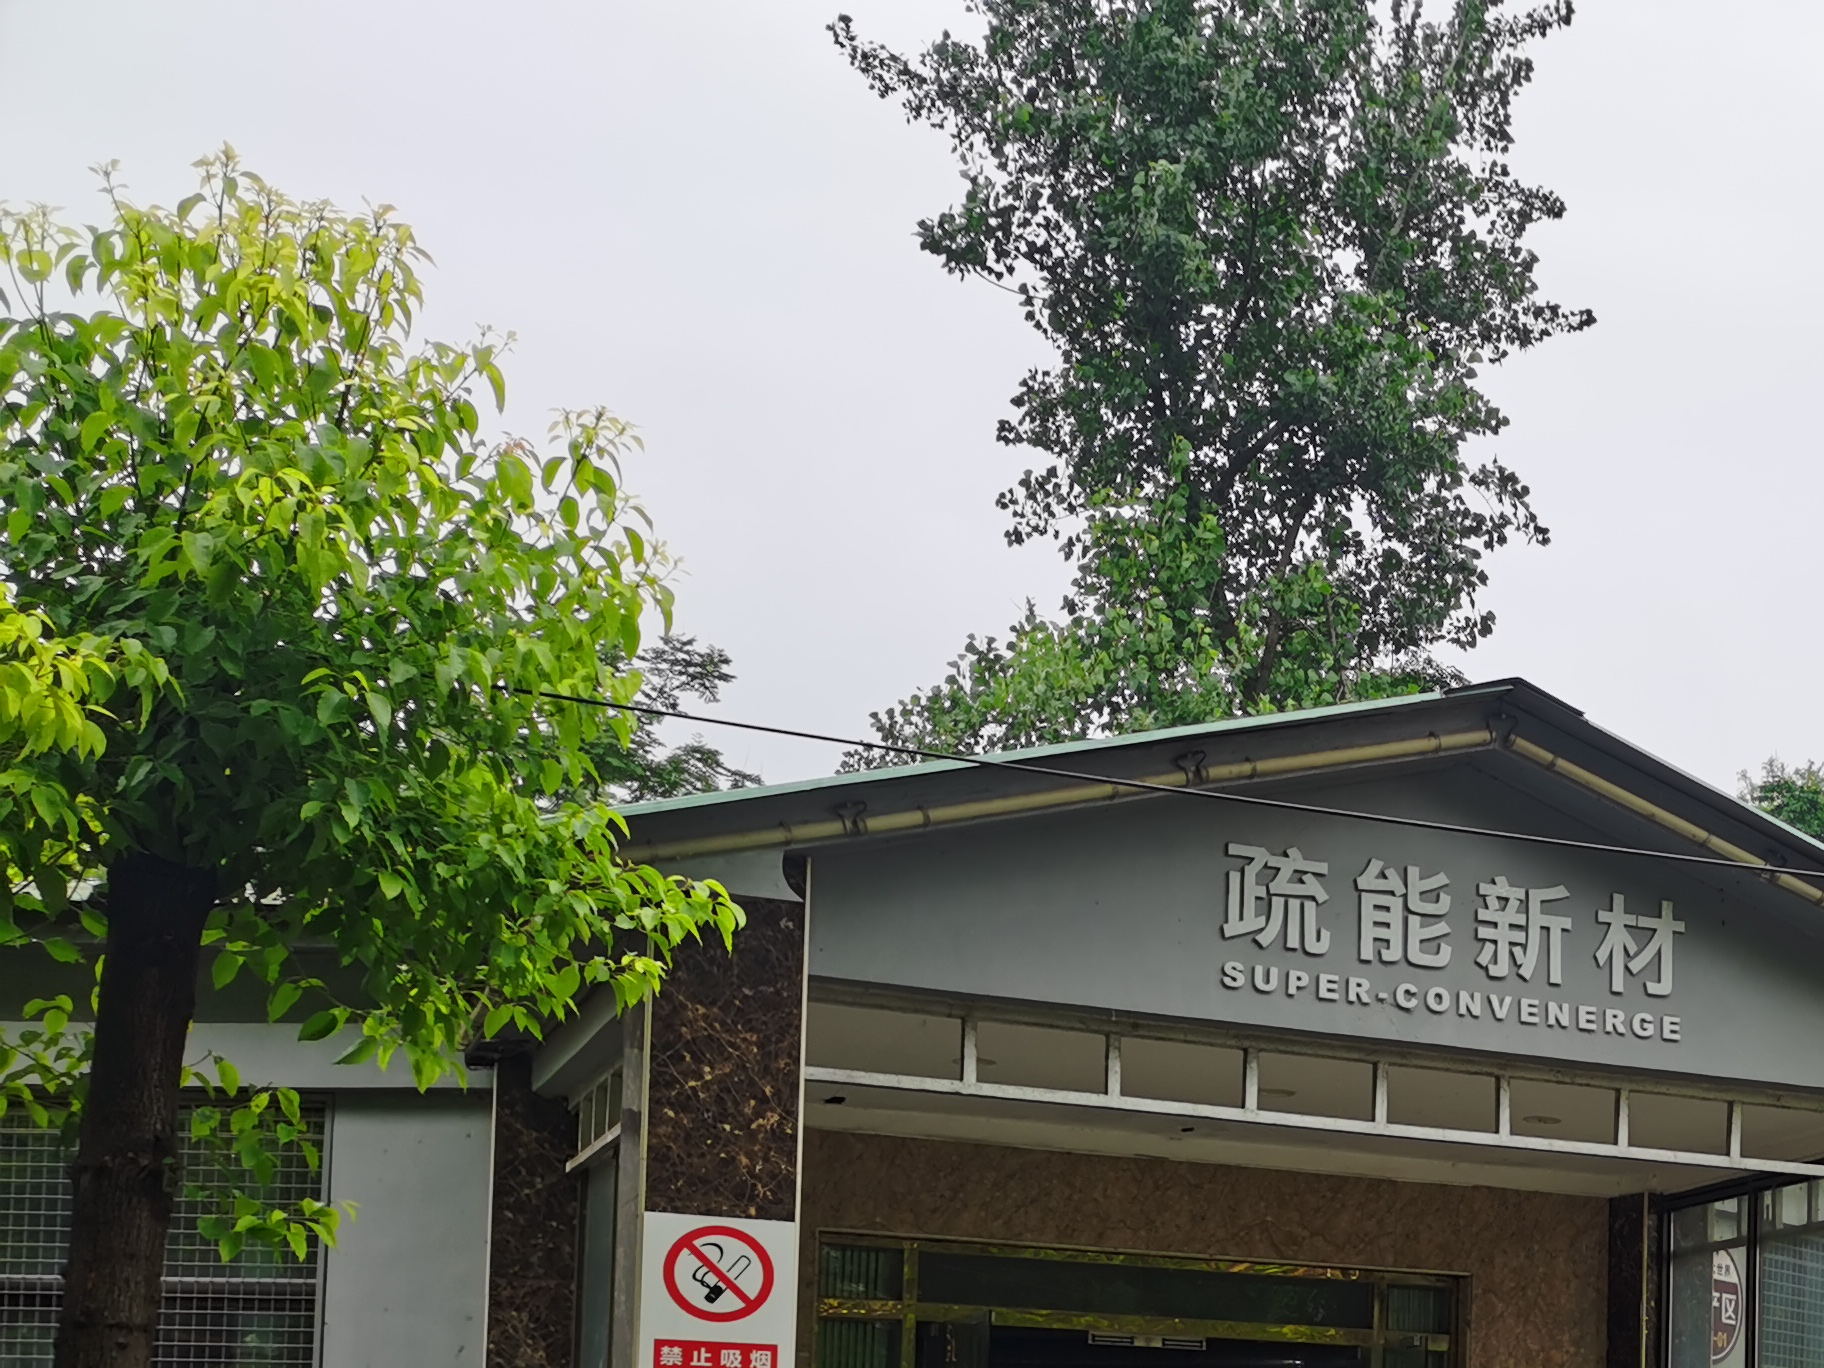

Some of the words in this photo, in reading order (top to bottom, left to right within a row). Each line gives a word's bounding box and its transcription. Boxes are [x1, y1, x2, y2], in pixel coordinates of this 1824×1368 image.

[1221, 842, 1686, 996] 疏能新材
[1221, 961, 1682, 1041] SUPER-CONVENERGE
